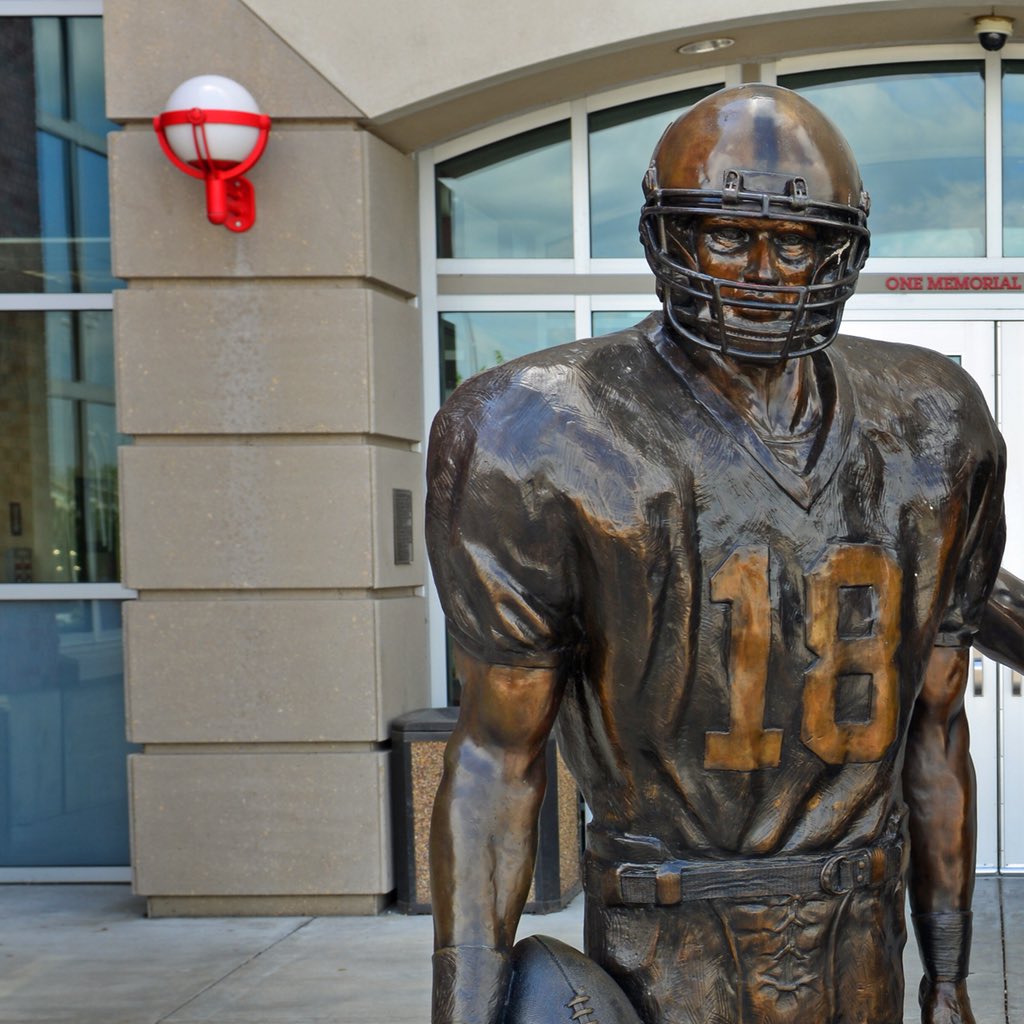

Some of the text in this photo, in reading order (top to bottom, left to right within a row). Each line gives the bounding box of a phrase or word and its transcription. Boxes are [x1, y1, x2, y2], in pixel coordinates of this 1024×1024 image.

[885, 275, 922, 290] ONE
[927, 275, 1022, 290] MEMORIAL
[704, 543, 903, 771] 18
